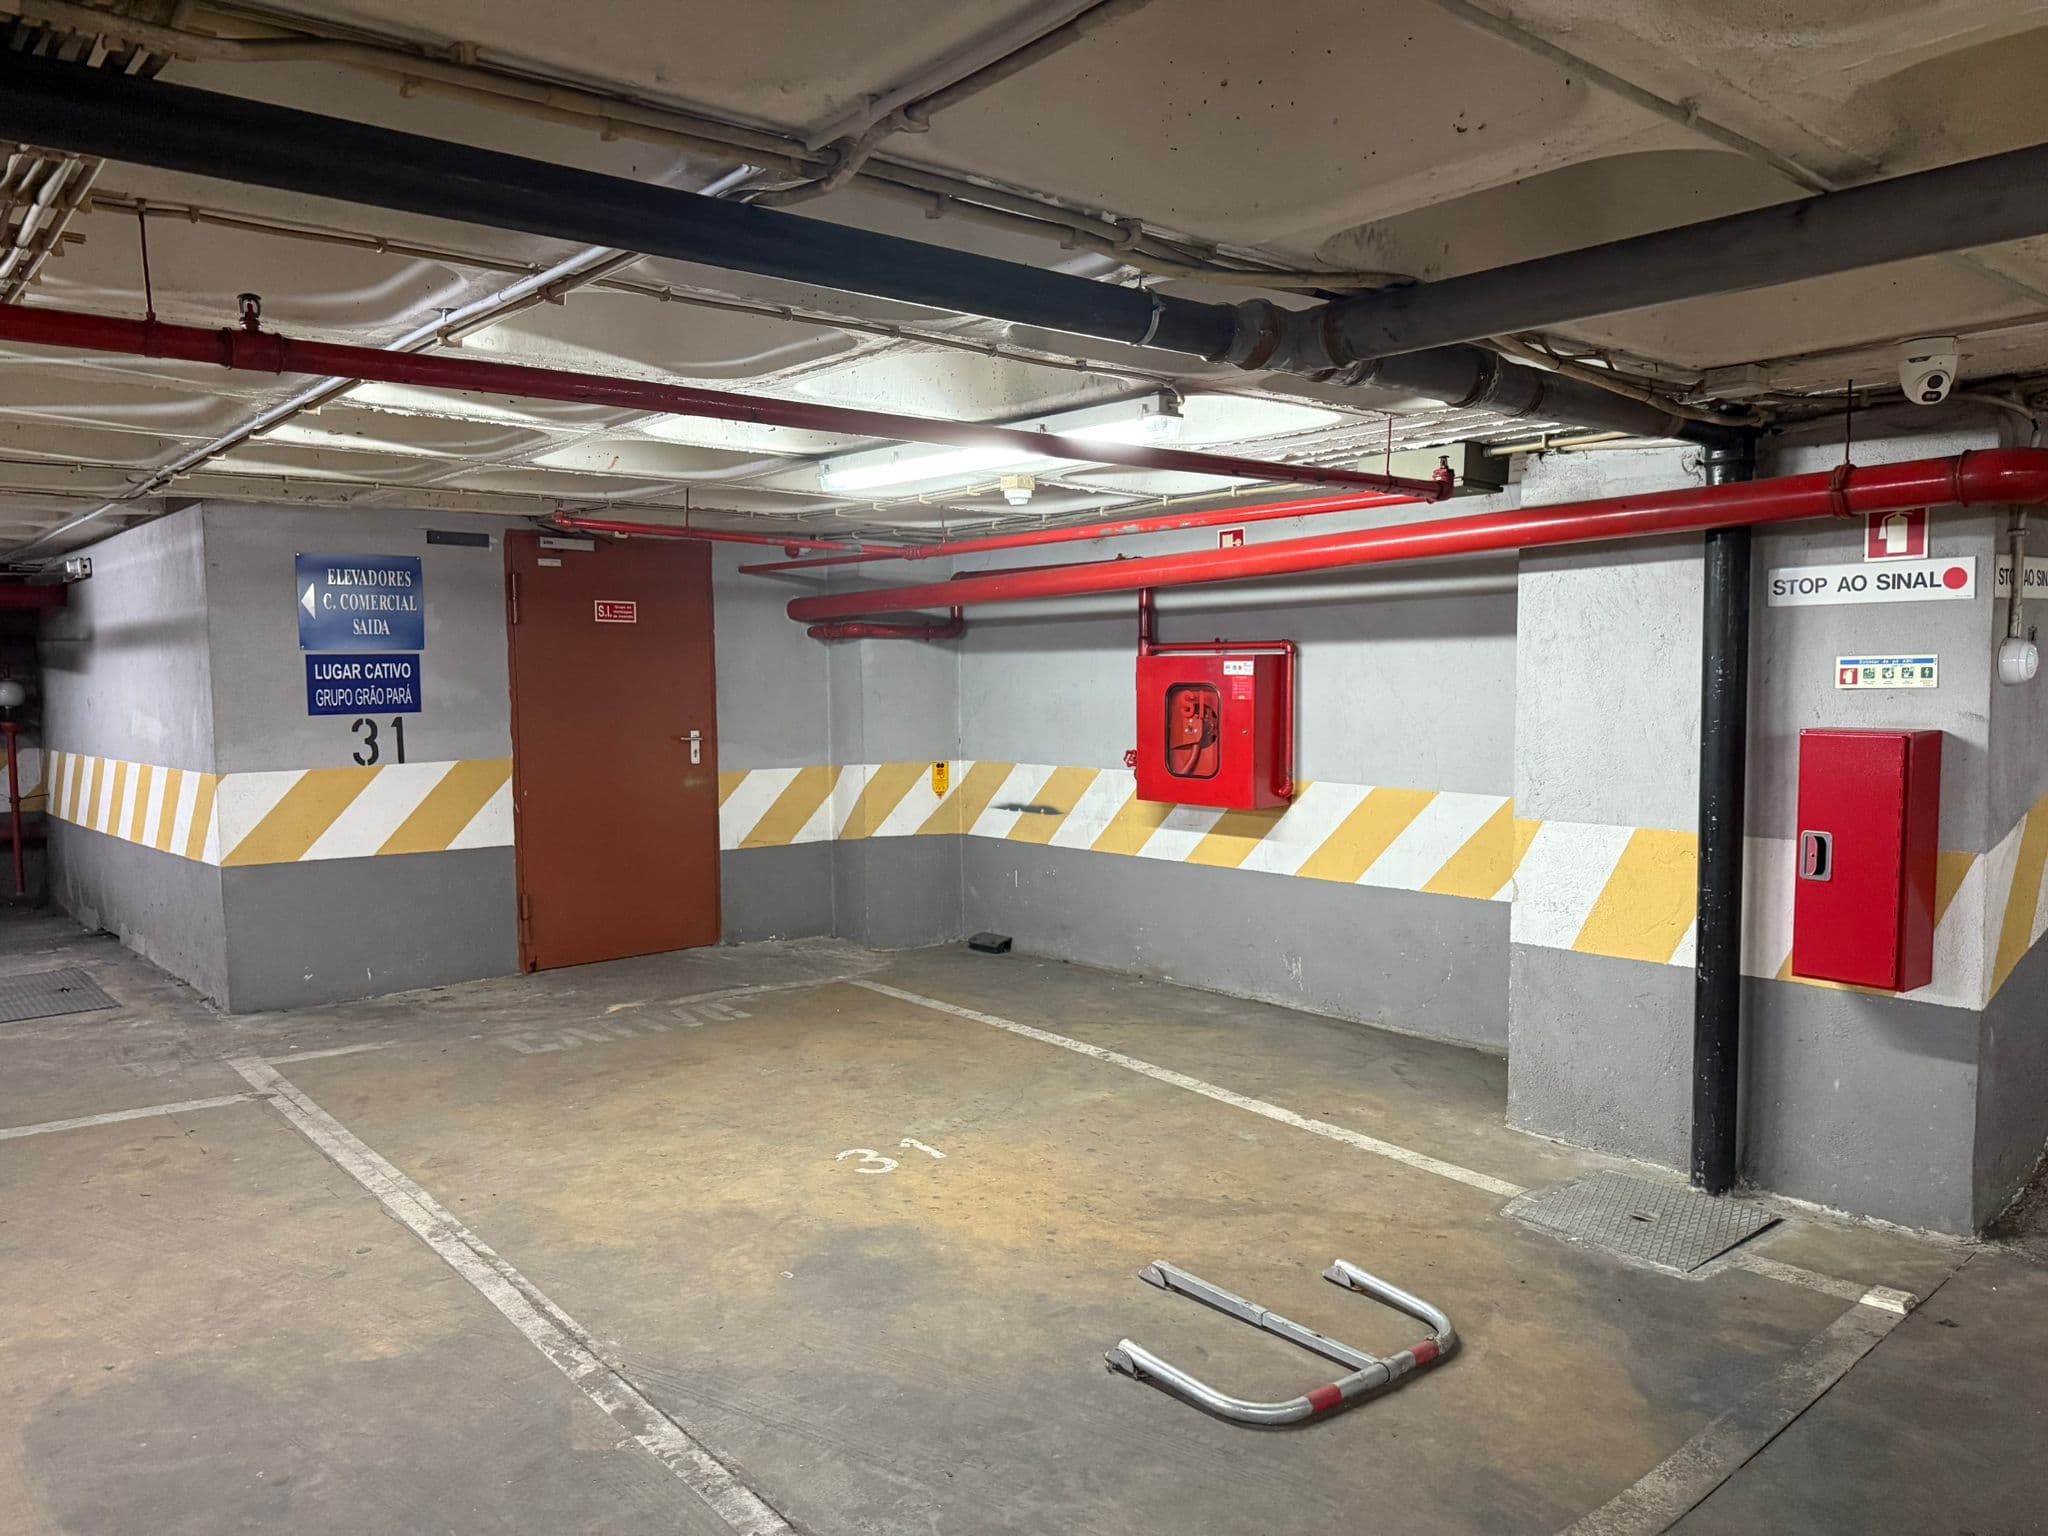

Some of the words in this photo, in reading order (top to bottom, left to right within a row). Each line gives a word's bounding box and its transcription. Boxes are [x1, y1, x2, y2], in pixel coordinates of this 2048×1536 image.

[327, 568, 412, 588] ELEVADORES
[1772, 577, 1828, 596] STOP
[1837, 574, 1868, 593] AO
[1876, 571, 1942, 591] SINAL
[1998, 567, 2015, 586] STO
[2023, 568, 2035, 586] AO
[323, 592, 337, 611] C.
[340, 593, 417, 612] COMERCIAL
[352, 618, 391, 636] SAIDA
[314, 663, 361, 681] LUGAR
[365, 662, 412, 680] CATIVO
[315, 688, 353, 708] GRUPO
[355, 684, 384, 706] GRÃO
[387, 682, 413, 705] PARÁ
[351, 716, 405, 766] 31
[834, 1137, 948, 1175] 31
